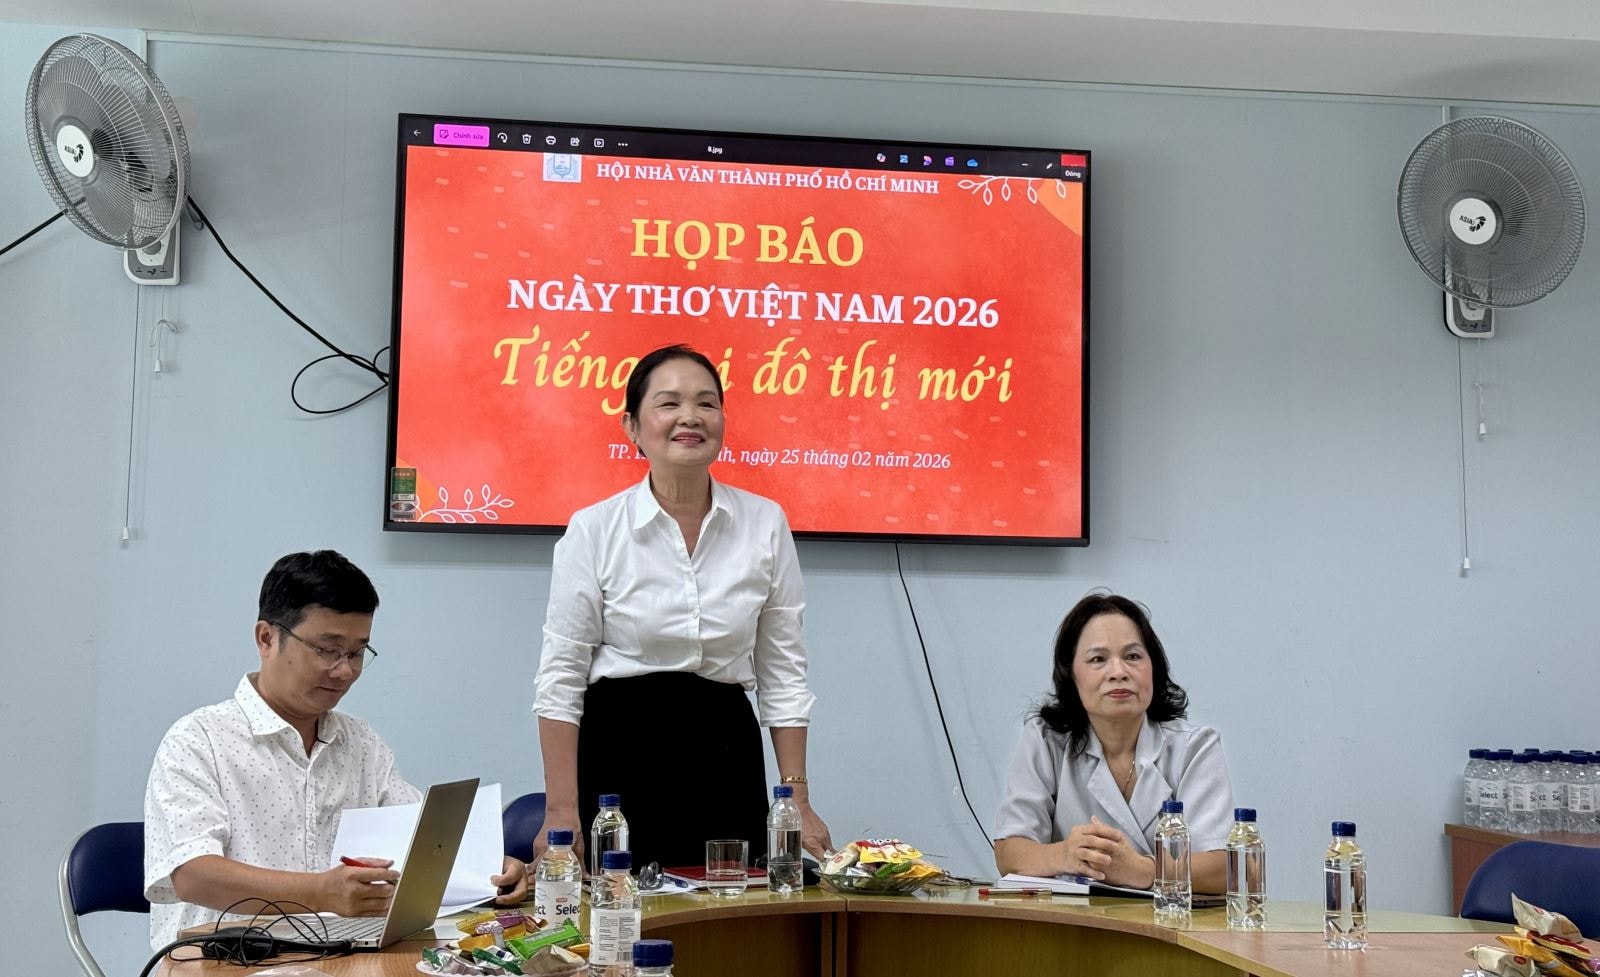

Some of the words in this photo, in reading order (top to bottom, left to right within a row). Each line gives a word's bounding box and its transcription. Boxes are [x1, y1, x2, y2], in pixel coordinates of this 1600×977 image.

[596, 160, 631, 182] HỘI
[634, 163, 675, 182] NHÀ
[677, 165, 715, 183] VĂN
[717, 167, 782, 187] THÀNH
[784, 168, 823, 189] PHỐ
[825, 169, 853, 190] HỒ
[855, 173, 887, 192] CHÍ
[890, 178, 939, 194] MINH
[631, 217, 746, 271] HỌP
[756, 216, 864, 267] BÁO
[506, 273, 621, 313] NGÀY
[626, 284, 716, 317] THƠ
[718, 282, 808, 328] VIỆT
[814, 292, 905, 325] NAM
[912, 295, 999, 328] 2026
[752, 336, 812, 396] đô
[827, 339, 897, 411] thị
[918, 355, 1013, 403] mới
[608, 443, 631, 460] TP.
[740, 448, 779, 467] ngày
[780, 449, 800, 465] 25
[803, 449, 849, 469] tháng
[851, 451, 871, 467] 02
[875, 450, 910, 468] năm
[912, 452, 951, 469] 2026
